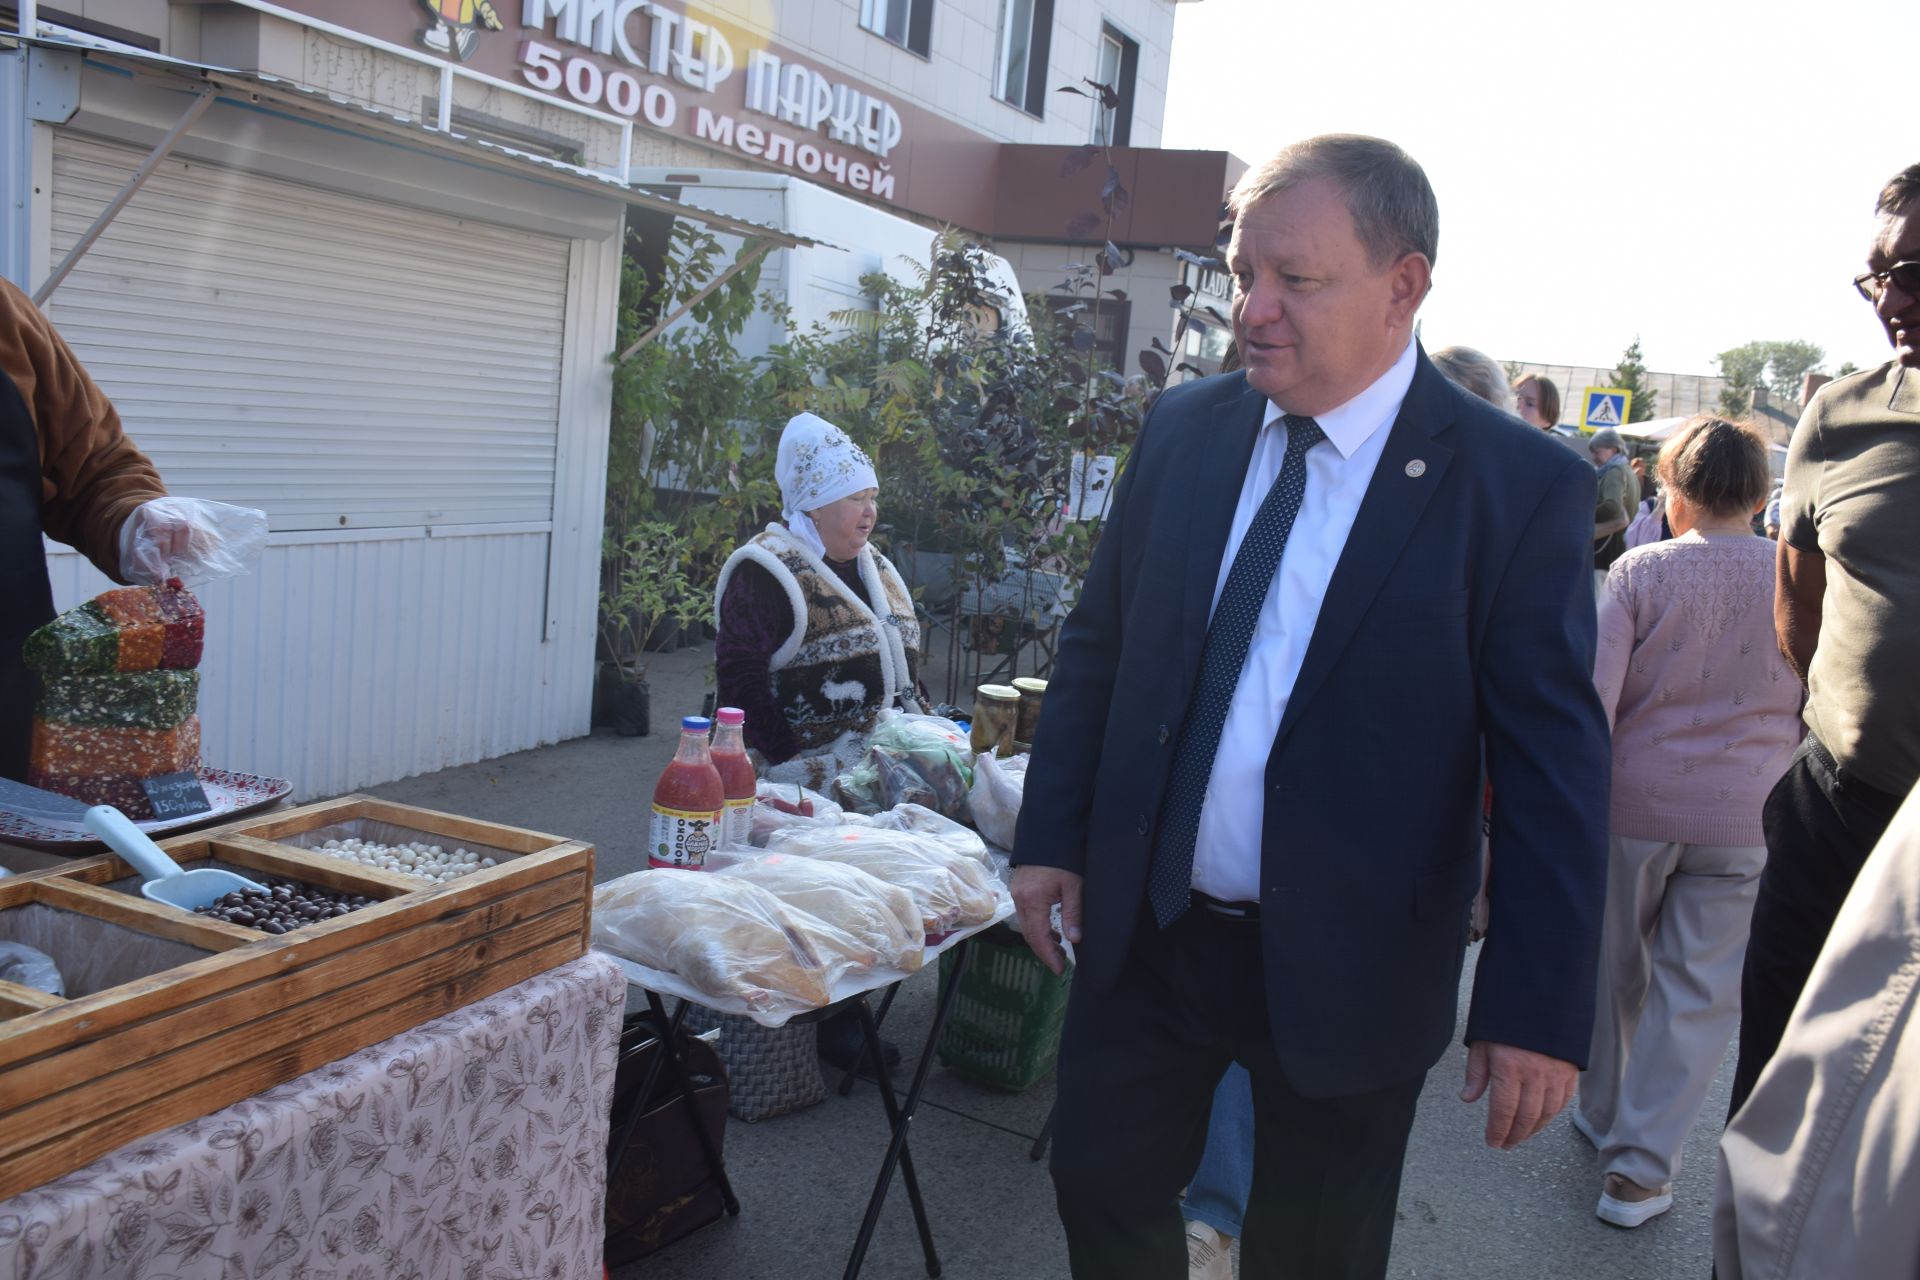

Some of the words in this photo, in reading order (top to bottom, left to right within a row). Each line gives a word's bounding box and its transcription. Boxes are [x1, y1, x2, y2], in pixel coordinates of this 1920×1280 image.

[522, 0, 735, 93] МИСТЕР
[746, 49, 902, 157] ПАРКЕР
[523, 40, 677, 128] 5000
[695, 106, 895, 200] мелочей
